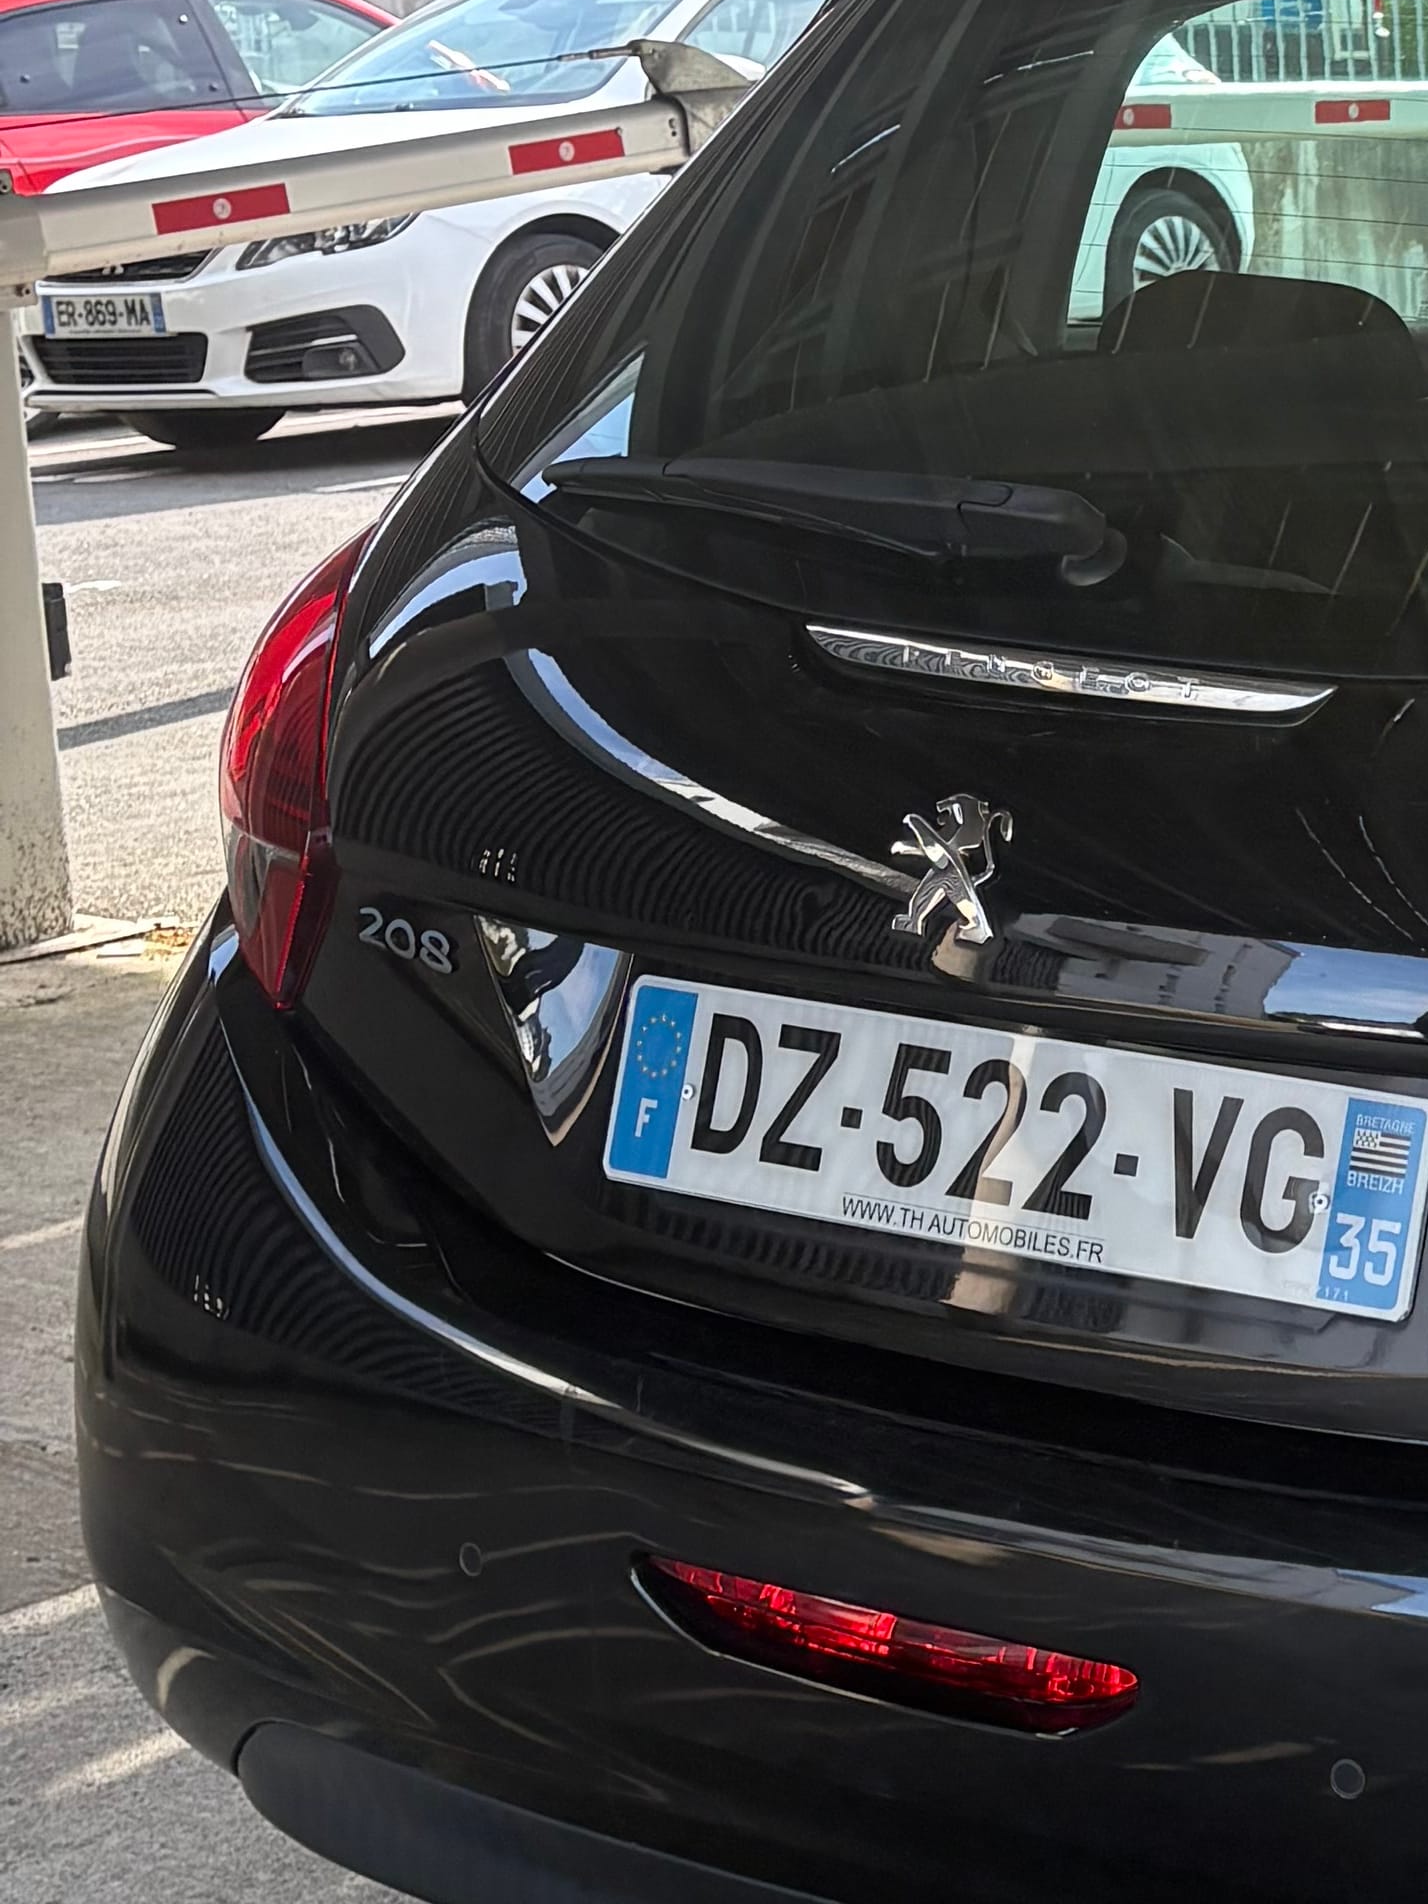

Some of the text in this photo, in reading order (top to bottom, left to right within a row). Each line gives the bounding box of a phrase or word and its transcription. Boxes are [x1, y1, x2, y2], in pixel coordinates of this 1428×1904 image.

[56, 299, 151, 327] ER-869-MA
[903, 645, 1200, 700] PEUGEOT
[359, 906, 453, 974] 208
[635, 1097, 658, 1138] F
[690, 1012, 1325, 1254] DZ-522-VG
[1356, 1113, 1415, 1137] BRETAGNE
[1347, 1170, 1405, 1194] BREIZH
[842, 1196, 1104, 1263] WWW.TH AUTOMOBILES.FR
[1329, 1212, 1402, 1287] 35
